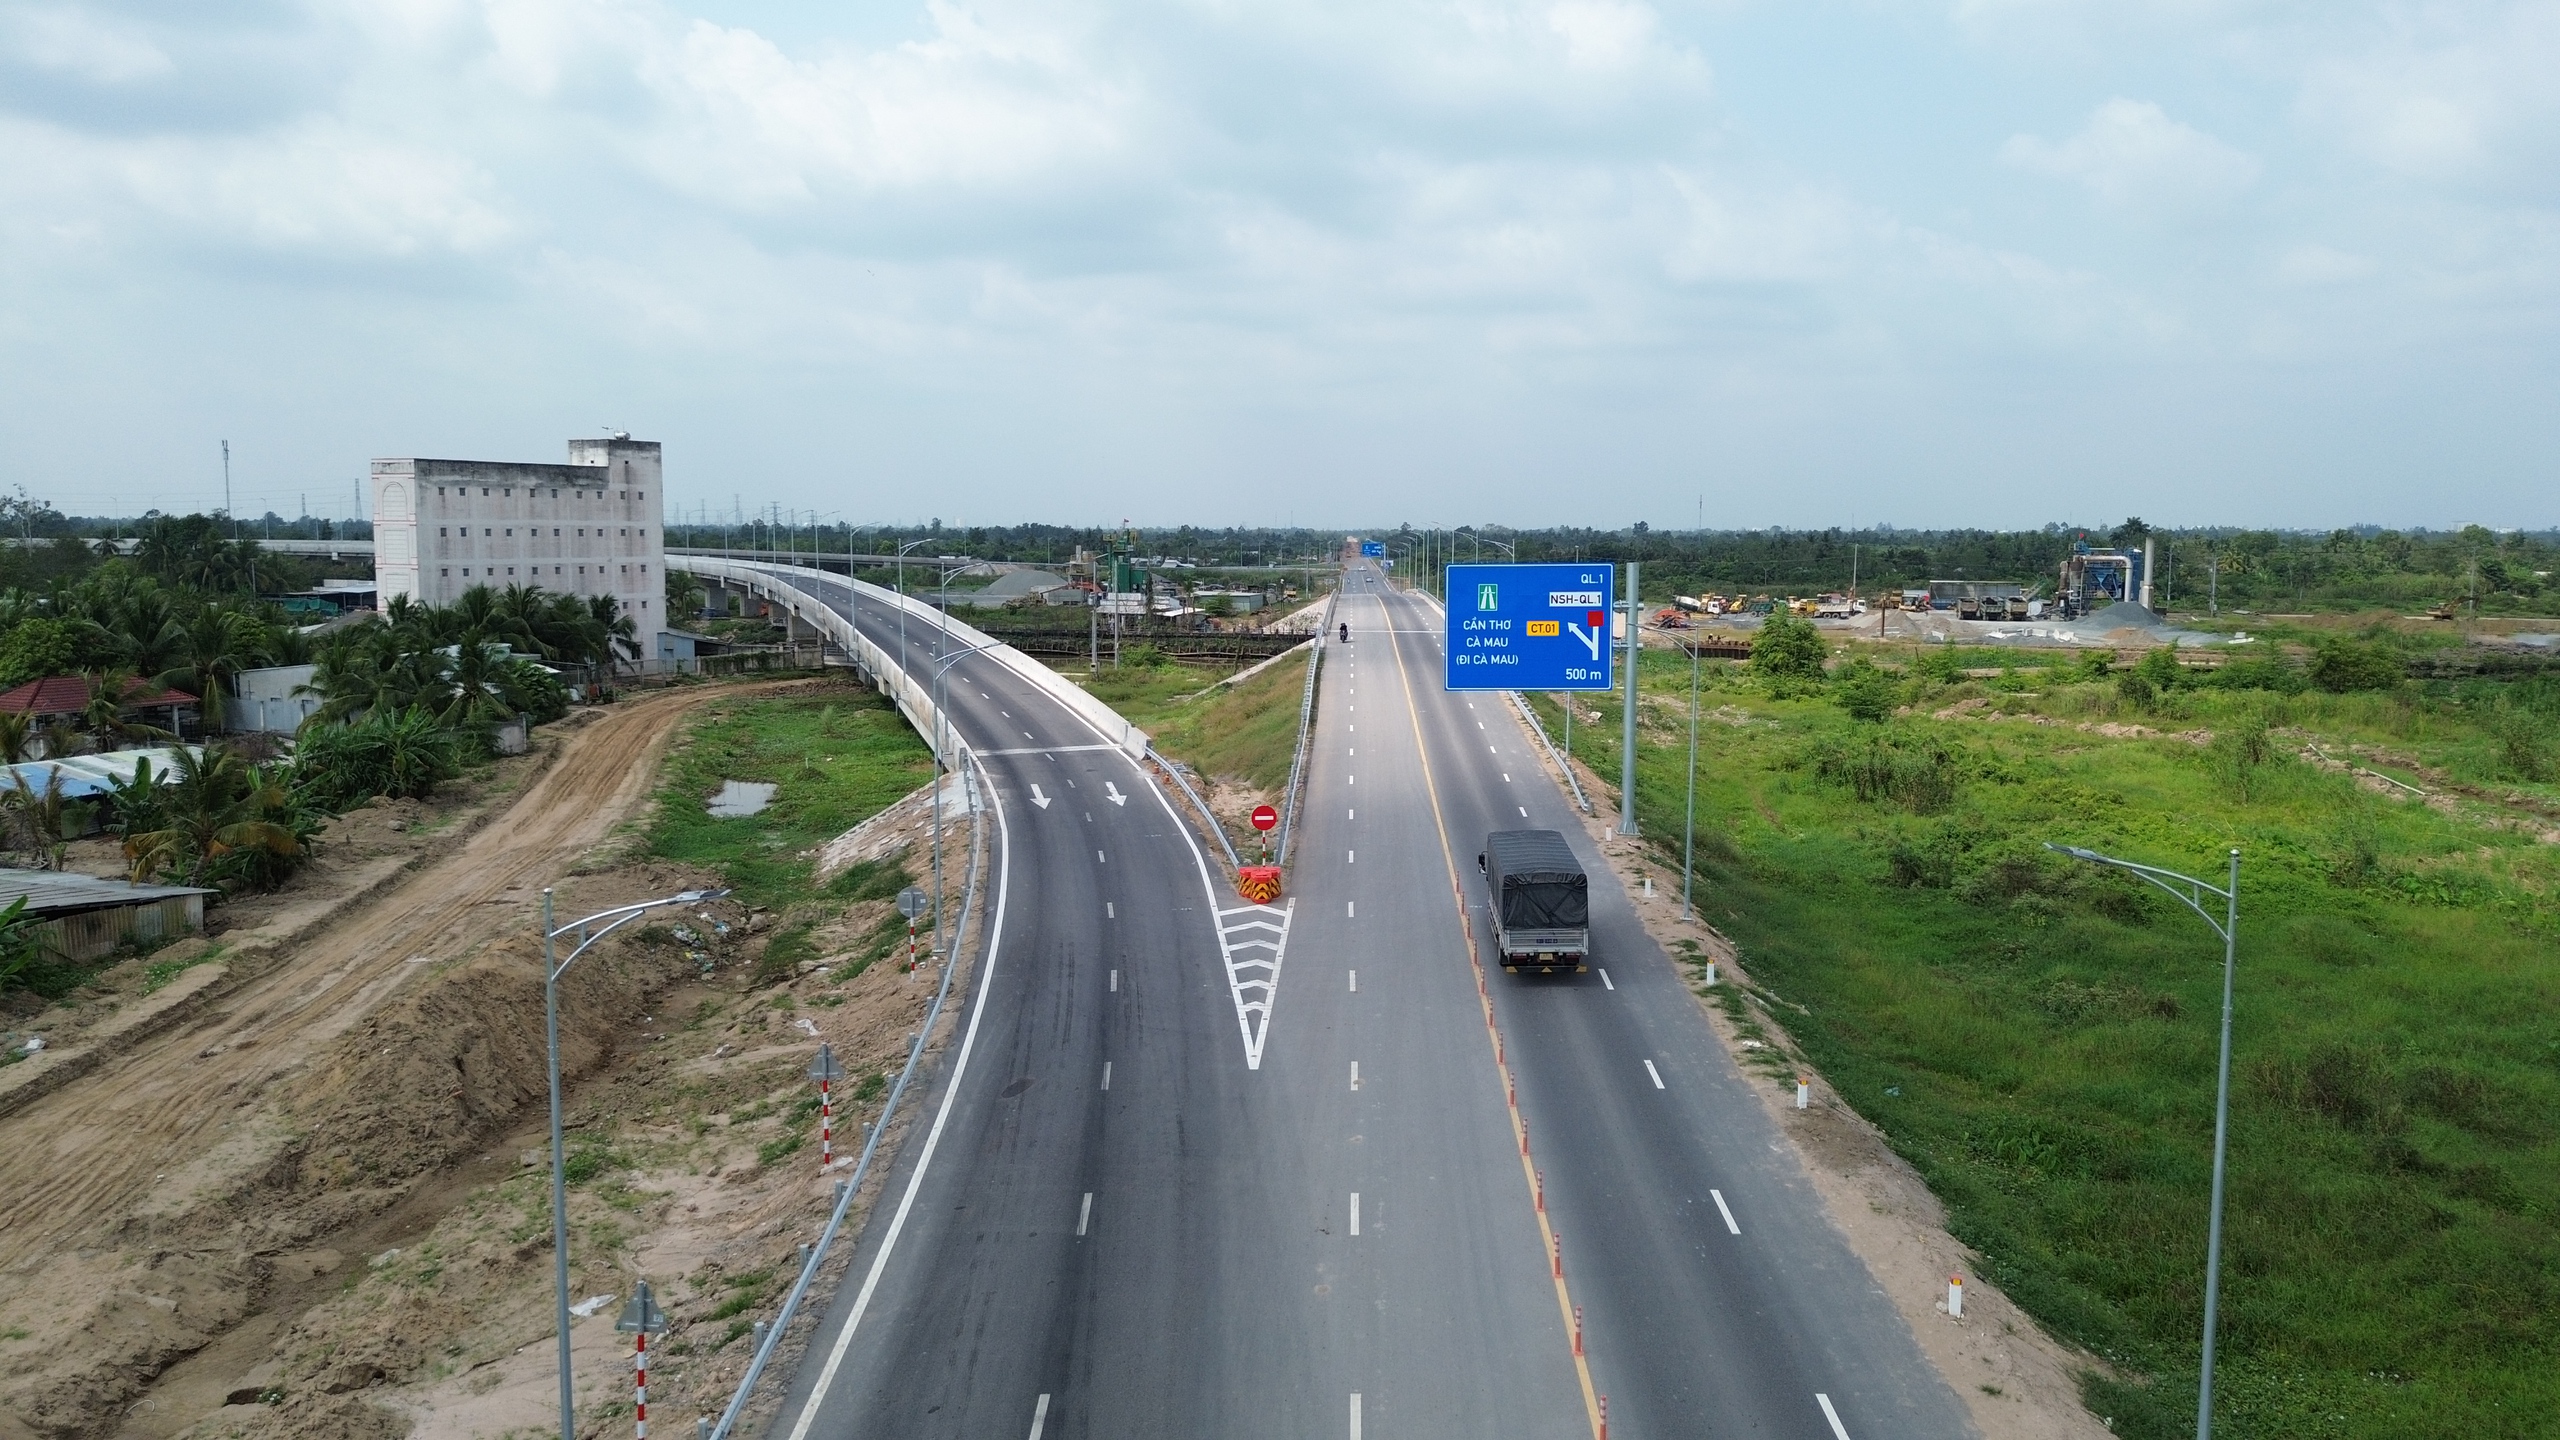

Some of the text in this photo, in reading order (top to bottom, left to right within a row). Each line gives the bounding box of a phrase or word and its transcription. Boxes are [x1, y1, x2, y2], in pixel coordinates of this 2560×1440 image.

[1581, 574, 1603, 584] QL.1
[1551, 595, 1601, 604] NSH-QL.1
[1489, 619, 1512, 630] THƠ
[1531, 624, 1556, 633] CT.01
[1466, 635, 1508, 647] CÀ MAU
[1456, 652, 1519, 666] (ĐI CÀ MAU)
[1566, 668, 1601, 680] 500 m
